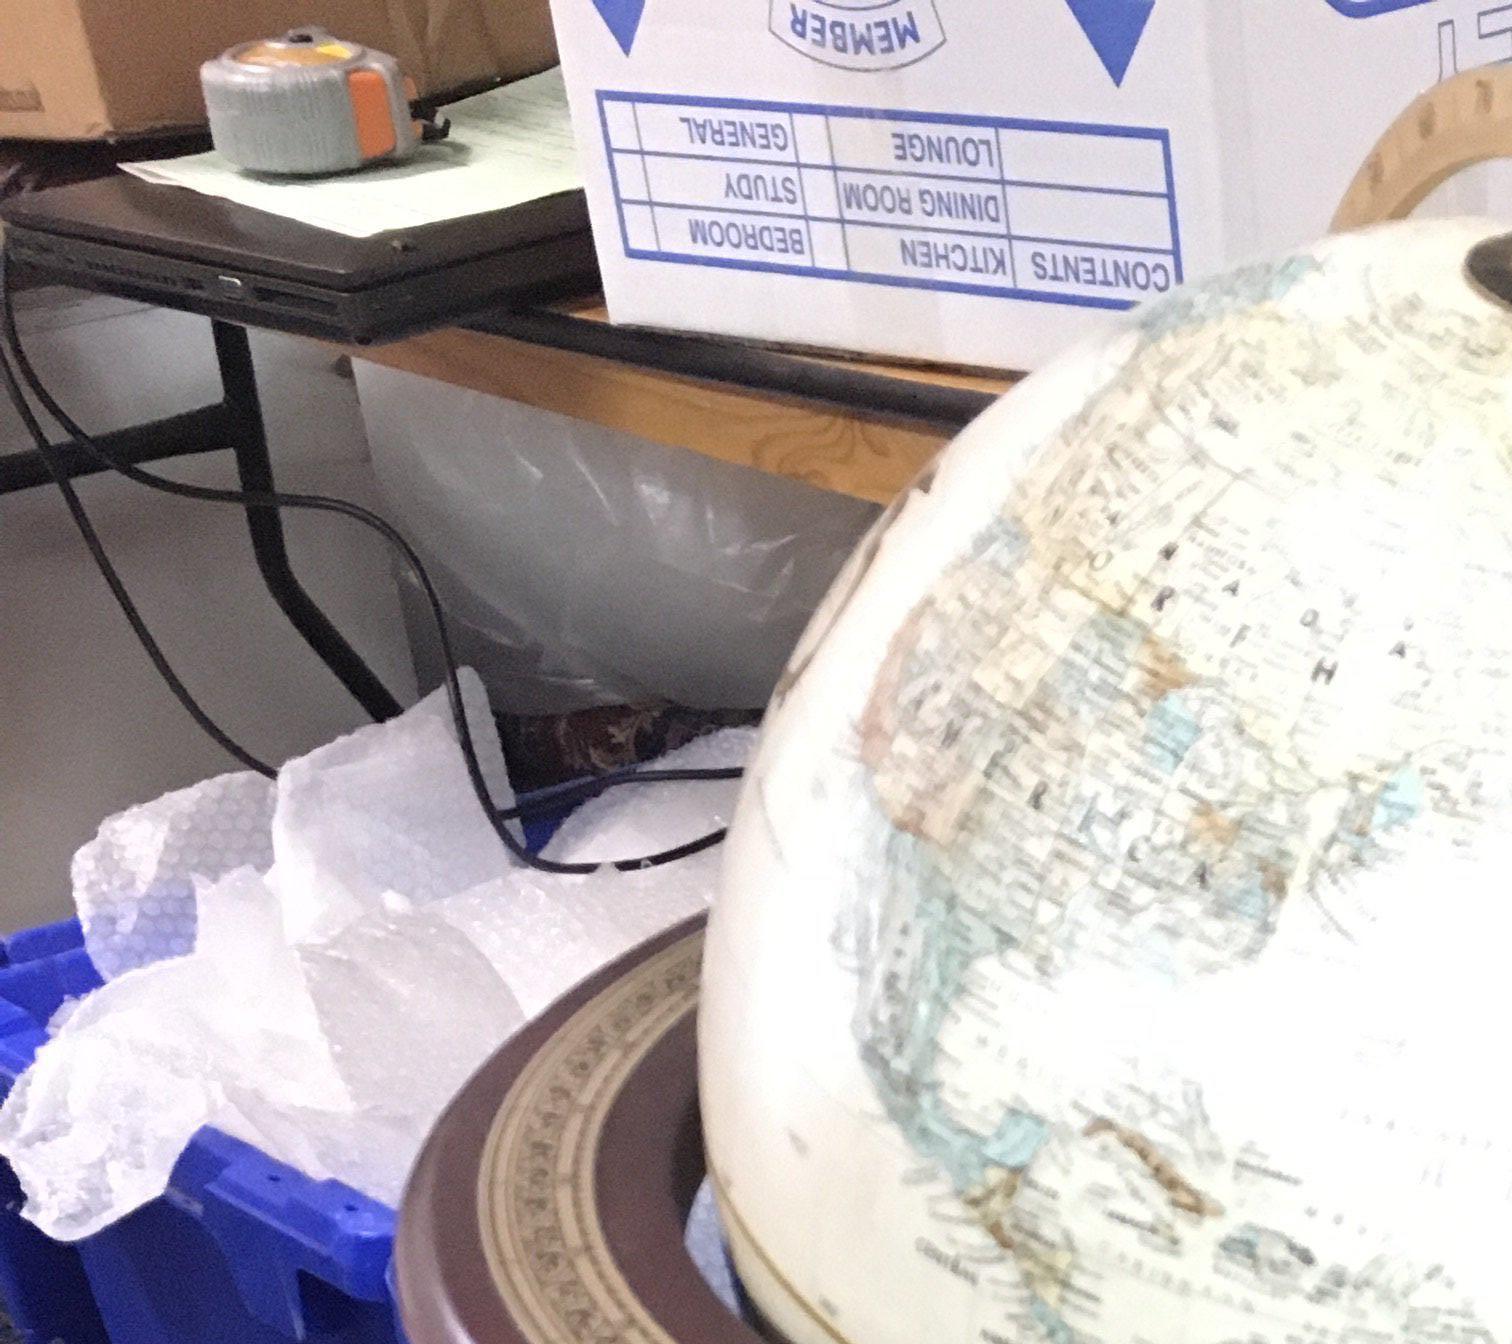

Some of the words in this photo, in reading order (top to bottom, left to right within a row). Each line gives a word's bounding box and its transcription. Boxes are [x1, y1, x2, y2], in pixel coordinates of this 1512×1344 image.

[790, 3, 921, 55] MEMBER
[679, 116, 789, 151] GENERAL
[891, 132, 994, 168] LOUNGE
[723, 172, 797, 204] STUDY
[843, 182, 913, 215] ROOM
[918, 188, 1000, 223] DINING
[688, 218, 805, 255] BEDROOM
[900, 238, 1007, 276] KITCHEN
[1031, 251, 1170, 292] CONTENTS
